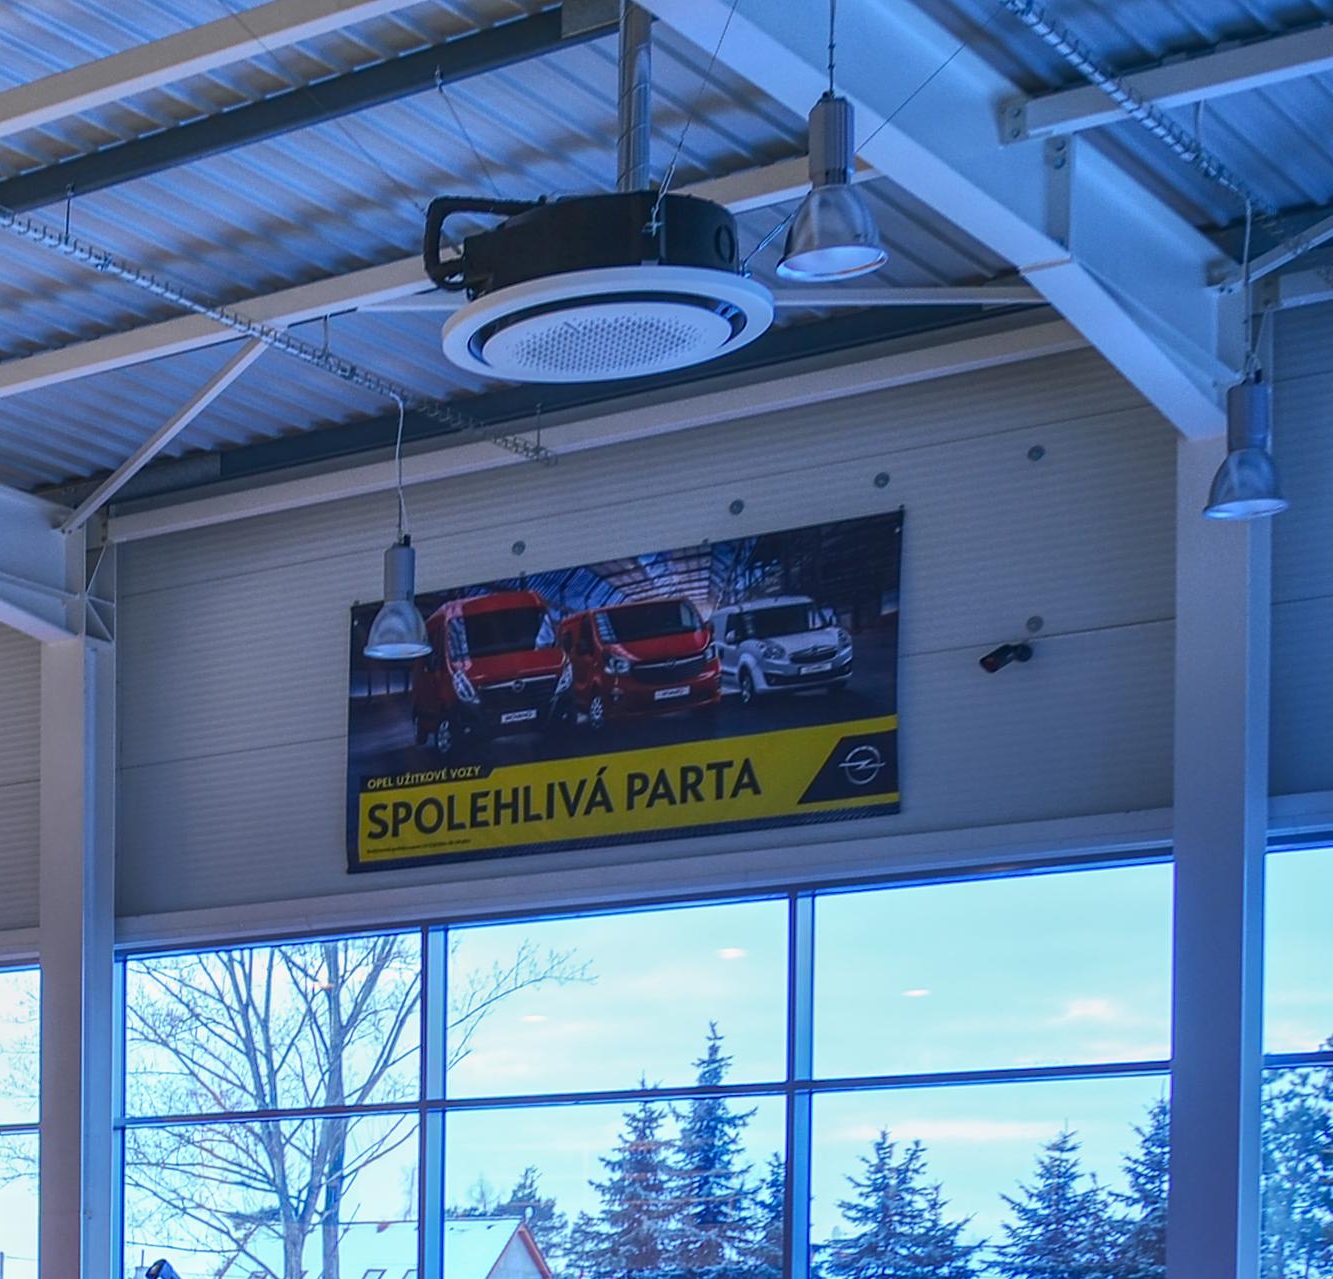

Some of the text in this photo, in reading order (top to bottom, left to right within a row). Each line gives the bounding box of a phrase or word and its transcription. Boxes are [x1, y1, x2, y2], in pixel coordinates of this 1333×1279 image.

[367, 765, 482, 789] OPEL UŽITKOVÉ VOZY
[367, 758, 762, 839] SPOLEHLIVÁ PARTA
